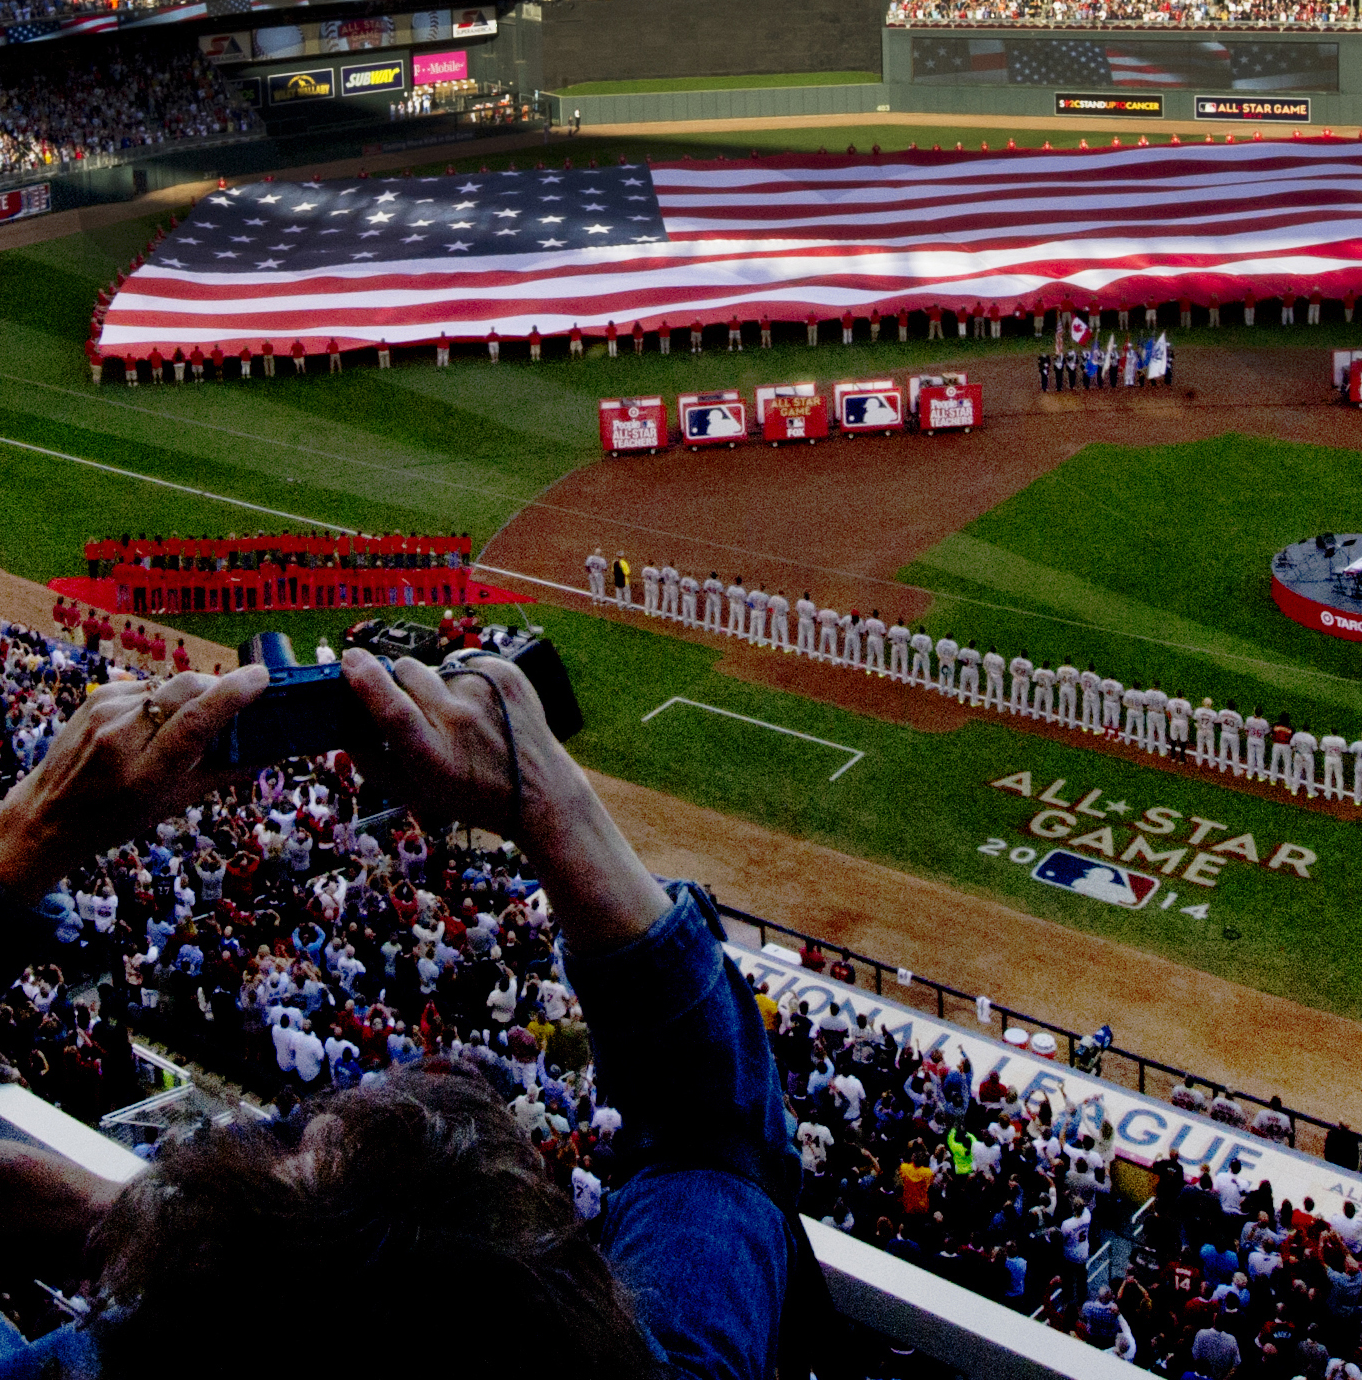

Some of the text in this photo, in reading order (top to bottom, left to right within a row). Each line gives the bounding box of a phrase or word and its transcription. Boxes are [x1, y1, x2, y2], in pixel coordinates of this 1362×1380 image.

[345, 67, 401, 89] SUBWAY
[1218, 103, 1307, 115] ALL STAR GAME
[771, 396, 821, 409] ALL STAR
[780, 406, 811, 417] GAME
[931, 417, 974, 428] TEACHERS
[786, 428, 805, 438] FOX
[613, 438, 659, 449] TEACHERS
[991, 771, 1318, 878] ALL STAR
[1030, 810, 1227, 887] GAME
[977, 838, 1211, 920] 20 14
